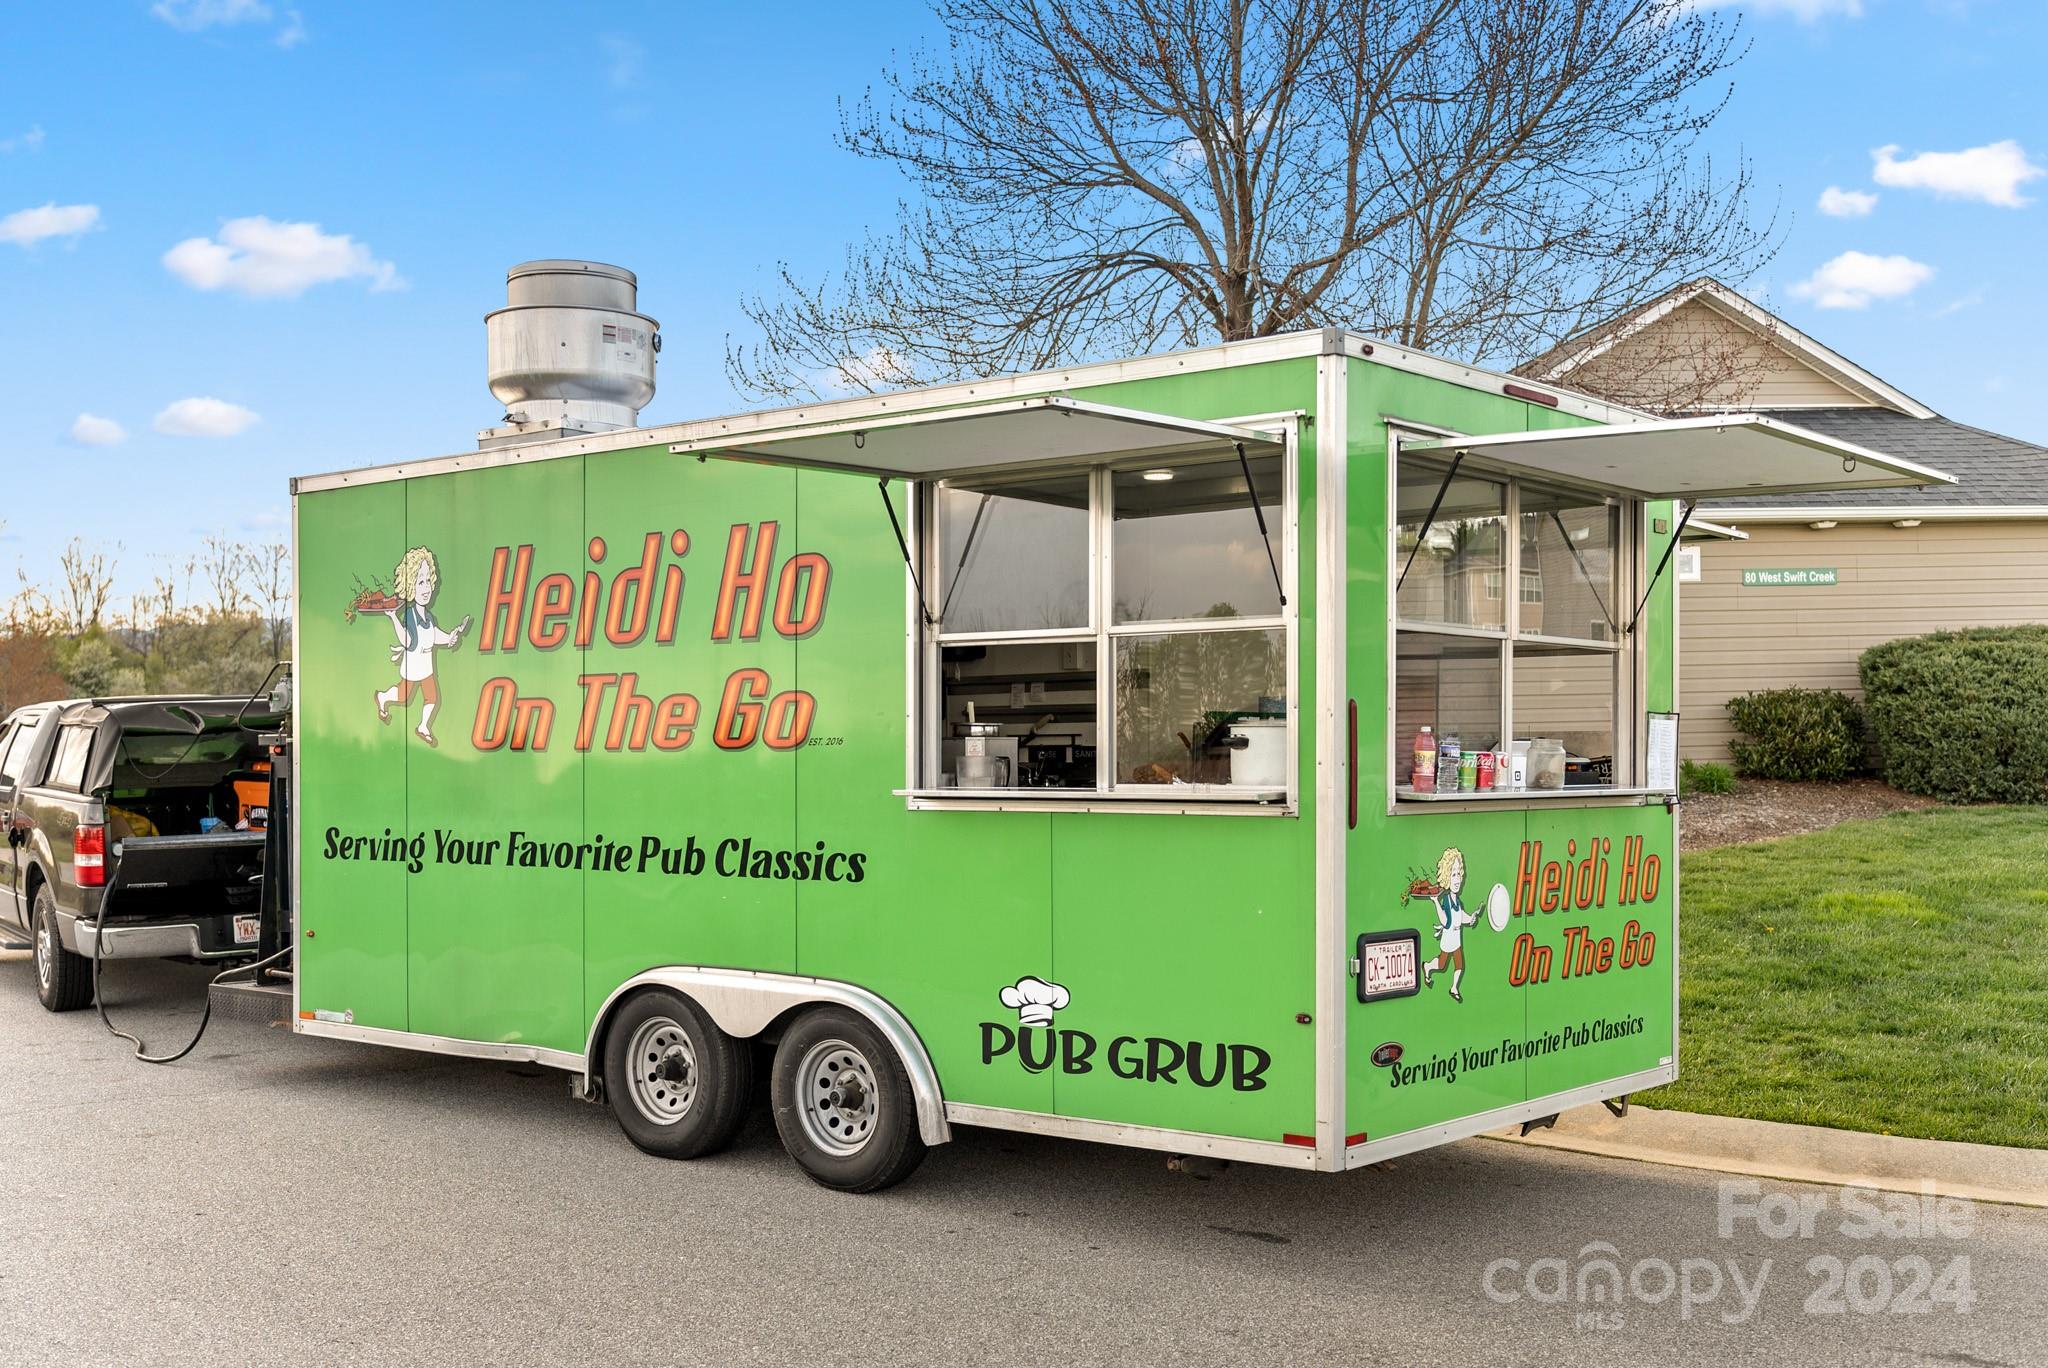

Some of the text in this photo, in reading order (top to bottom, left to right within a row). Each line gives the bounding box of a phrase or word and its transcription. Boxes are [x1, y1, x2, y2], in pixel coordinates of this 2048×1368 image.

[479, 520, 833, 655] Heidi Ho
[1758, 572, 1782, 583] West
[1783, 571, 1807, 583] Swift
[1809, 571, 1835, 582] Creek
[471, 667, 818, 752] On The Go
[808, 737, 844, 746] EST. 2016
[323, 826, 867, 882] Serving Your Favorite Pub Classics
[1513, 835, 1661, 917] Heidi Ho
[1368, 952, 1413, 982] CK-10074
[1379, 944, 1402, 953] TRAILER
[1508, 920, 1656, 987] On The Go
[978, 1022, 1272, 1092] PUB GRUB
[1390, 1051, 1458, 1088] Serving
[1461, 1046, 1498, 1073] Your
[1501, 1030, 1560, 1064] Favorite
[1562, 1022, 1590, 1050] Pub
[1591, 1013, 1644, 1043] Classics
